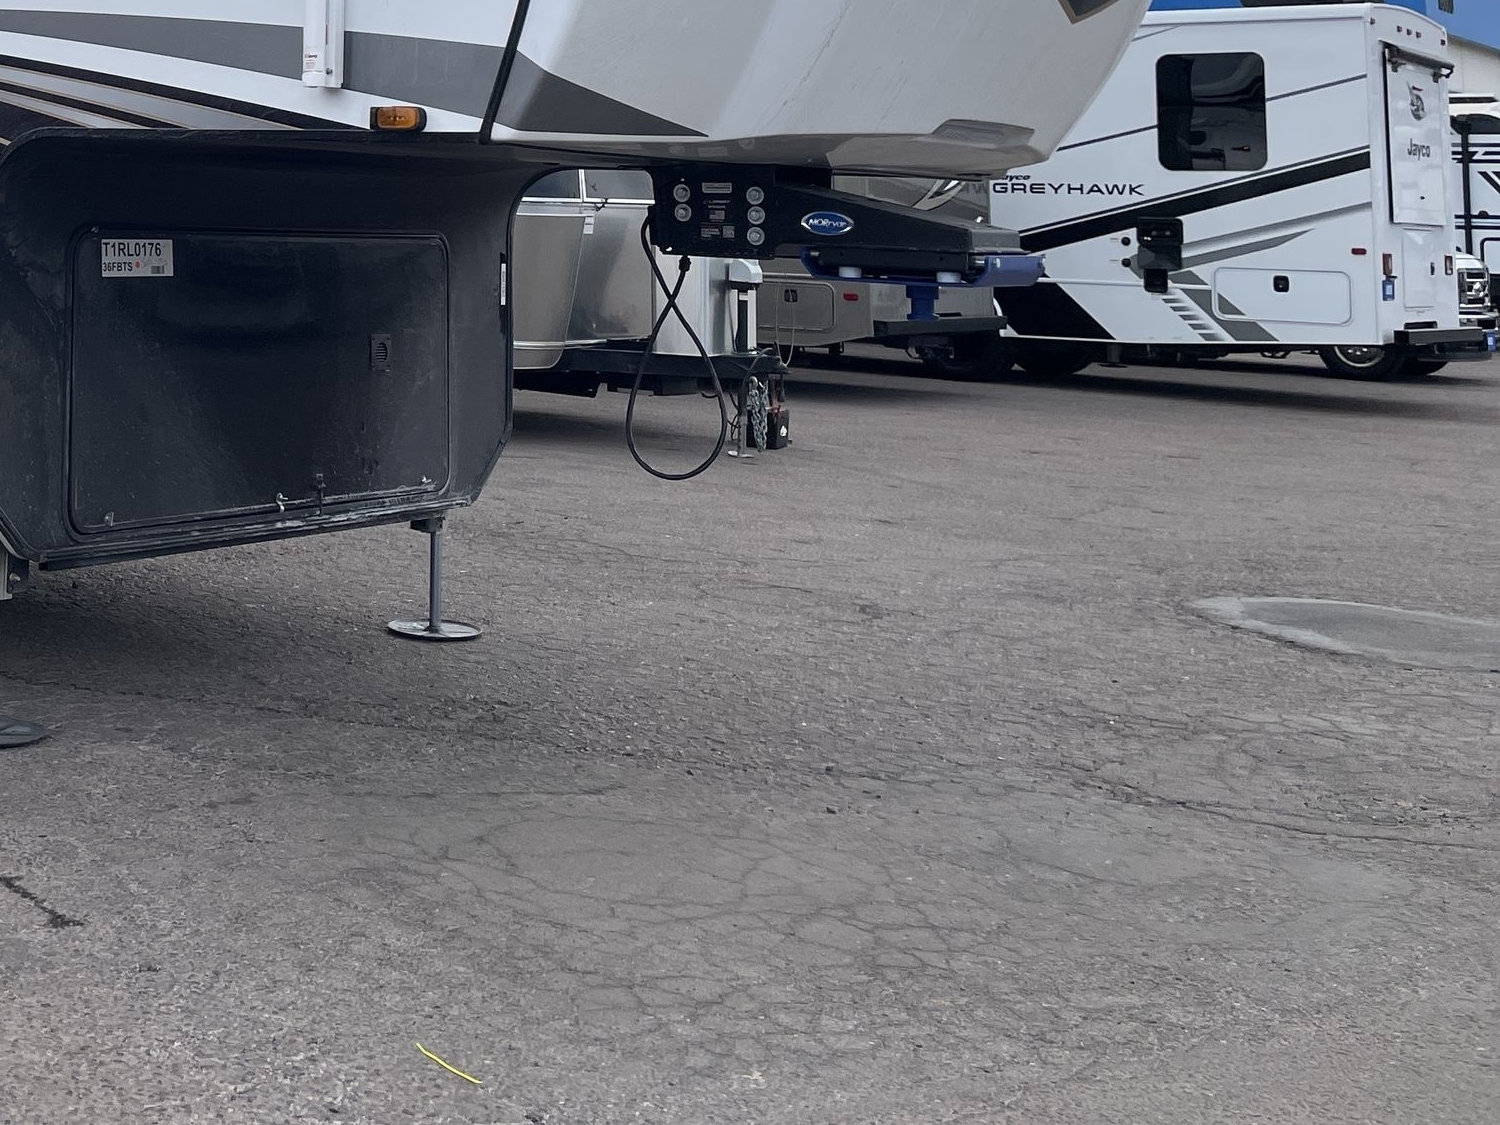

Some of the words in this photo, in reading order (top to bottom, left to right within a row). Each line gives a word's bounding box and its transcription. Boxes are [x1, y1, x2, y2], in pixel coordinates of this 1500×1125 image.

[1407, 138, 1431, 161] Jayco
[992, 182, 1145, 196] GREYHAWK
[103, 242, 162, 257] T1RL0176
[103, 262, 133, 272] 36FBTS
